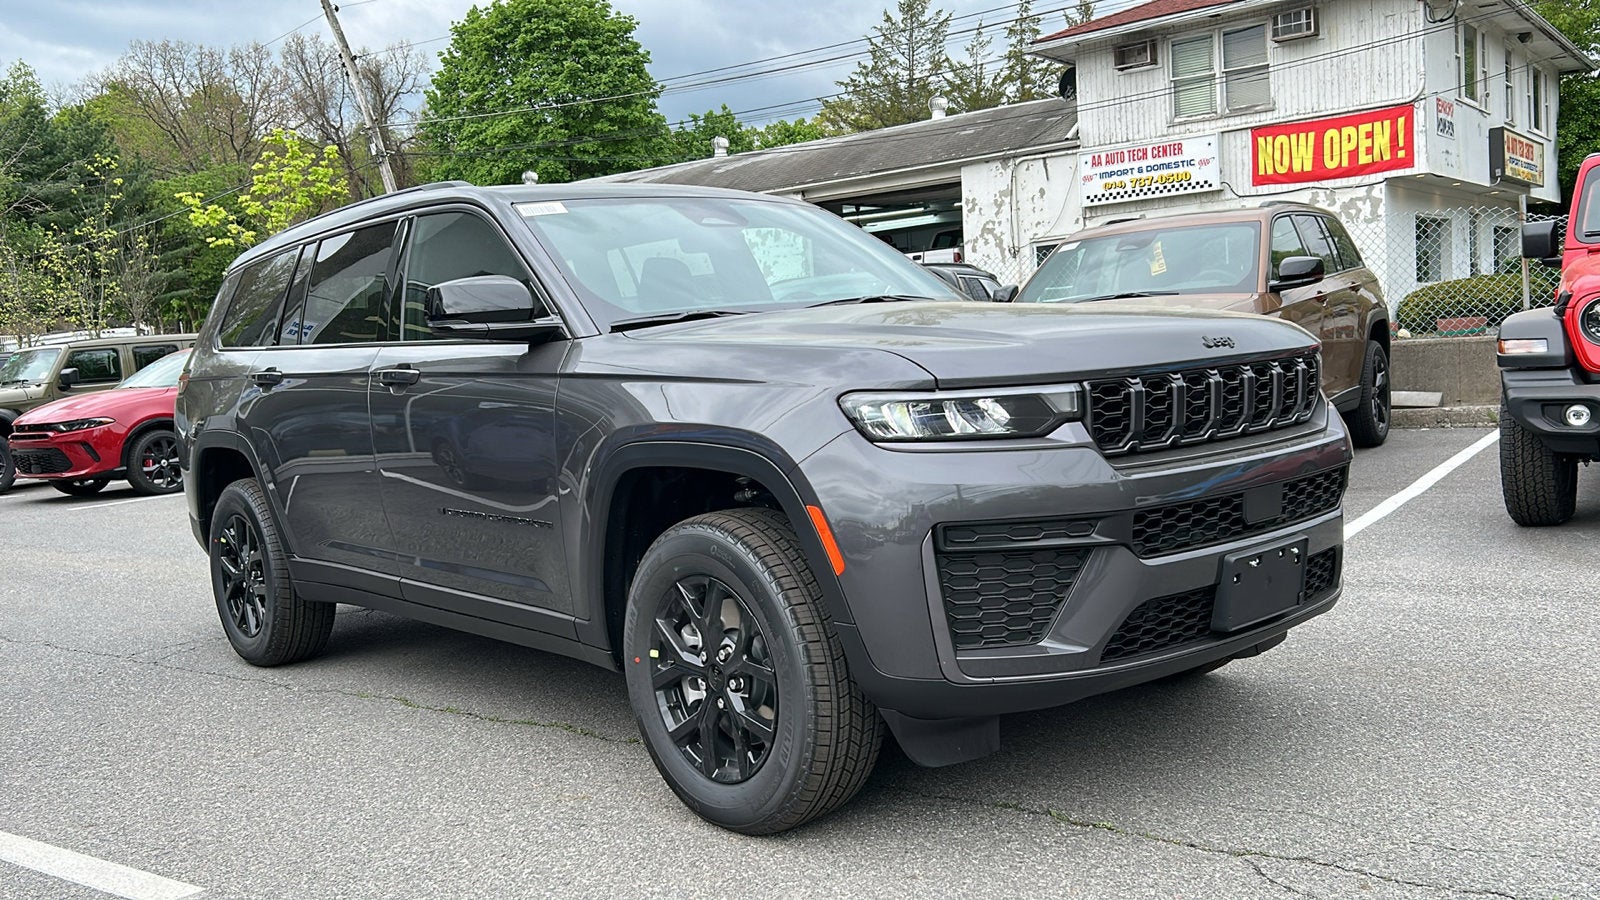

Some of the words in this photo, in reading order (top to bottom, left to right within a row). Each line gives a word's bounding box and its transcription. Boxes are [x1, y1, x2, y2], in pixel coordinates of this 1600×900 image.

[1091, 154, 1103, 168] AA
[1105, 150, 1125, 166] AUTO
[1127, 147, 1148, 162] TECH
[1151, 142, 1183, 159] CENTER
[1257, 131, 1317, 176] NOW
[1323, 120, 1390, 170] OPEN
[1099, 167, 1135, 179] IMPORT
[1137, 166, 1144, 174] &
[1145, 158, 1196, 172] DOMESTIC
[1130, 171, 1192, 188] 737-0500
[1201, 335, 1236, 349] Jeep
